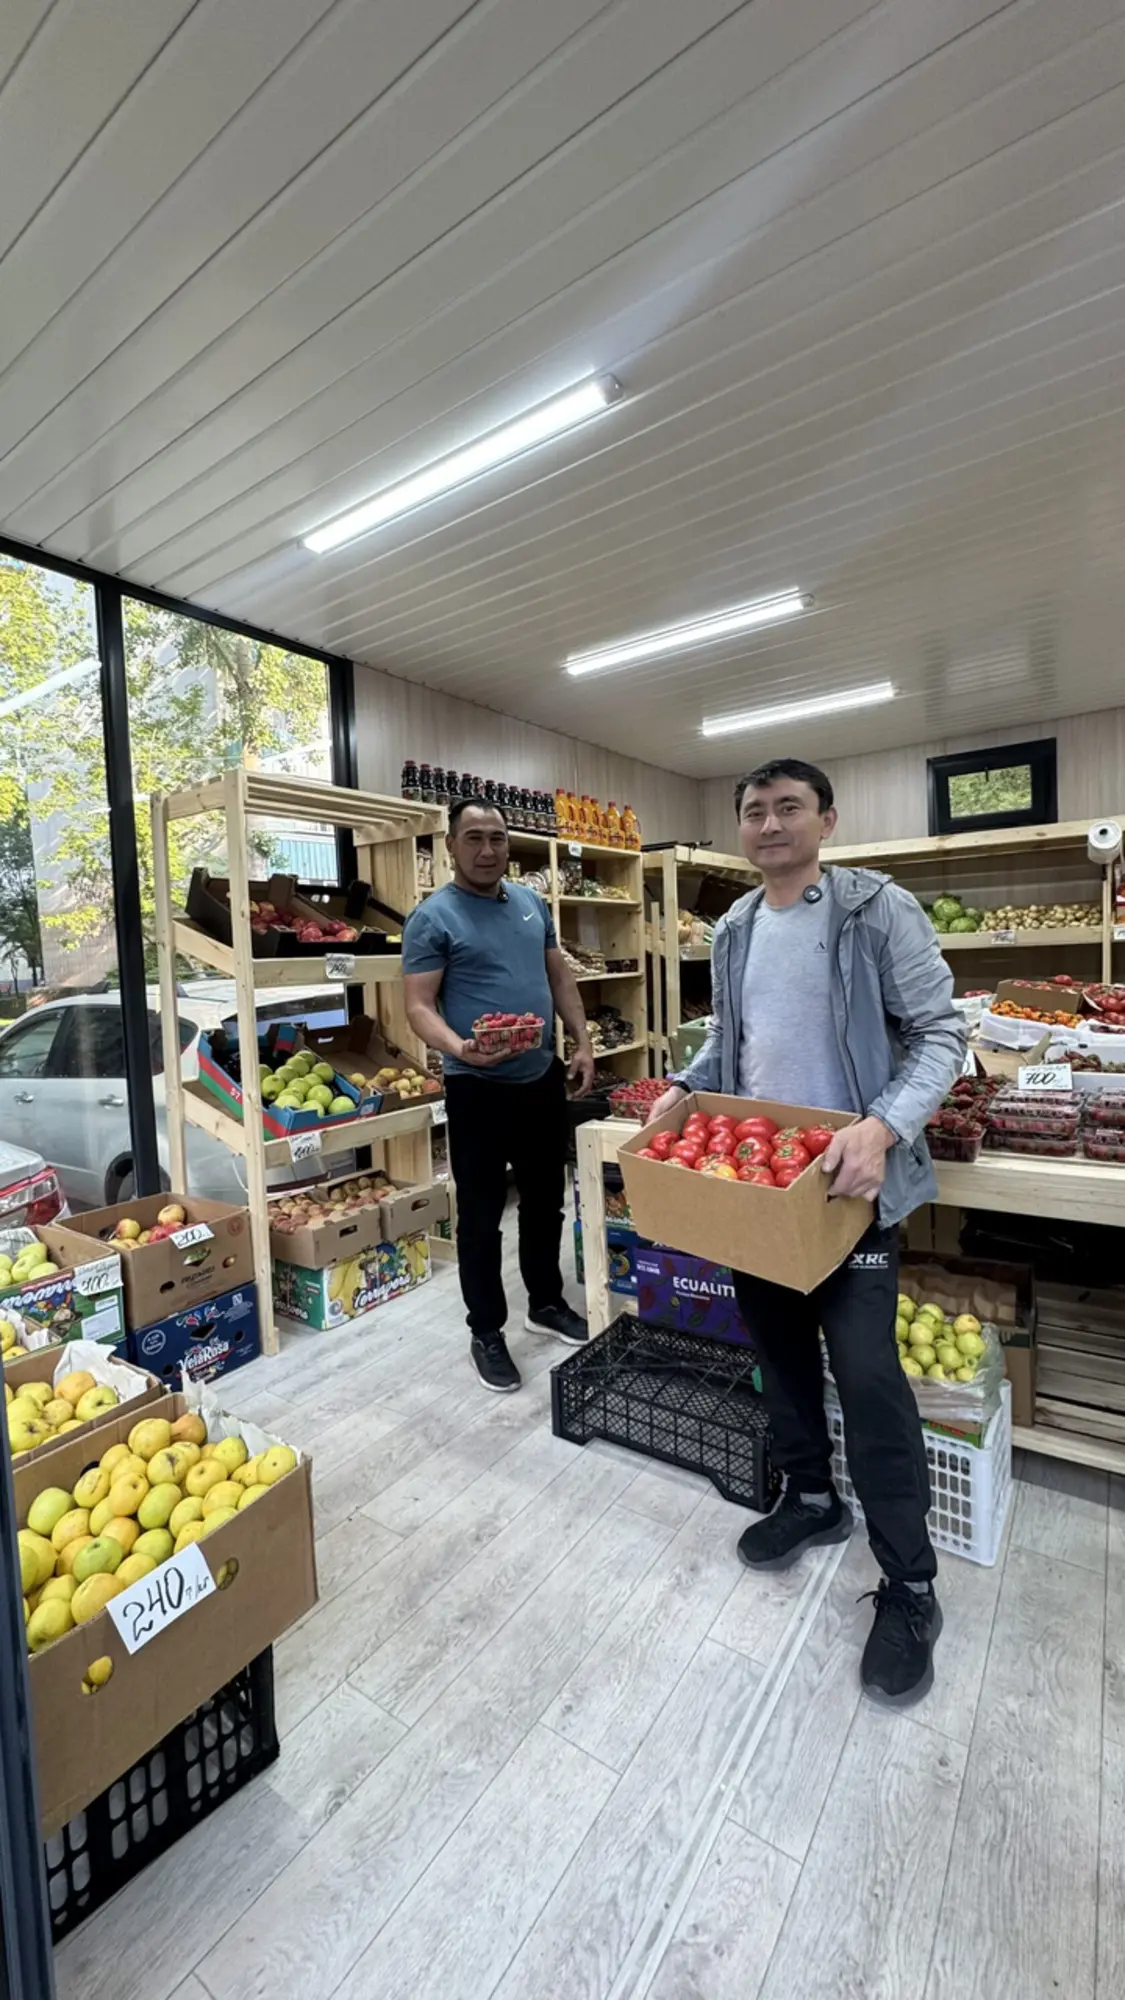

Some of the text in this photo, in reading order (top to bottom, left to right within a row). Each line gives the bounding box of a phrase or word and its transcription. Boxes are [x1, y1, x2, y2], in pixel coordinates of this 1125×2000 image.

[1025, 1071, 1057, 1085] 700
[849, 1252, 889, 1265] XRC
[122, 1566, 185, 1642] 240
